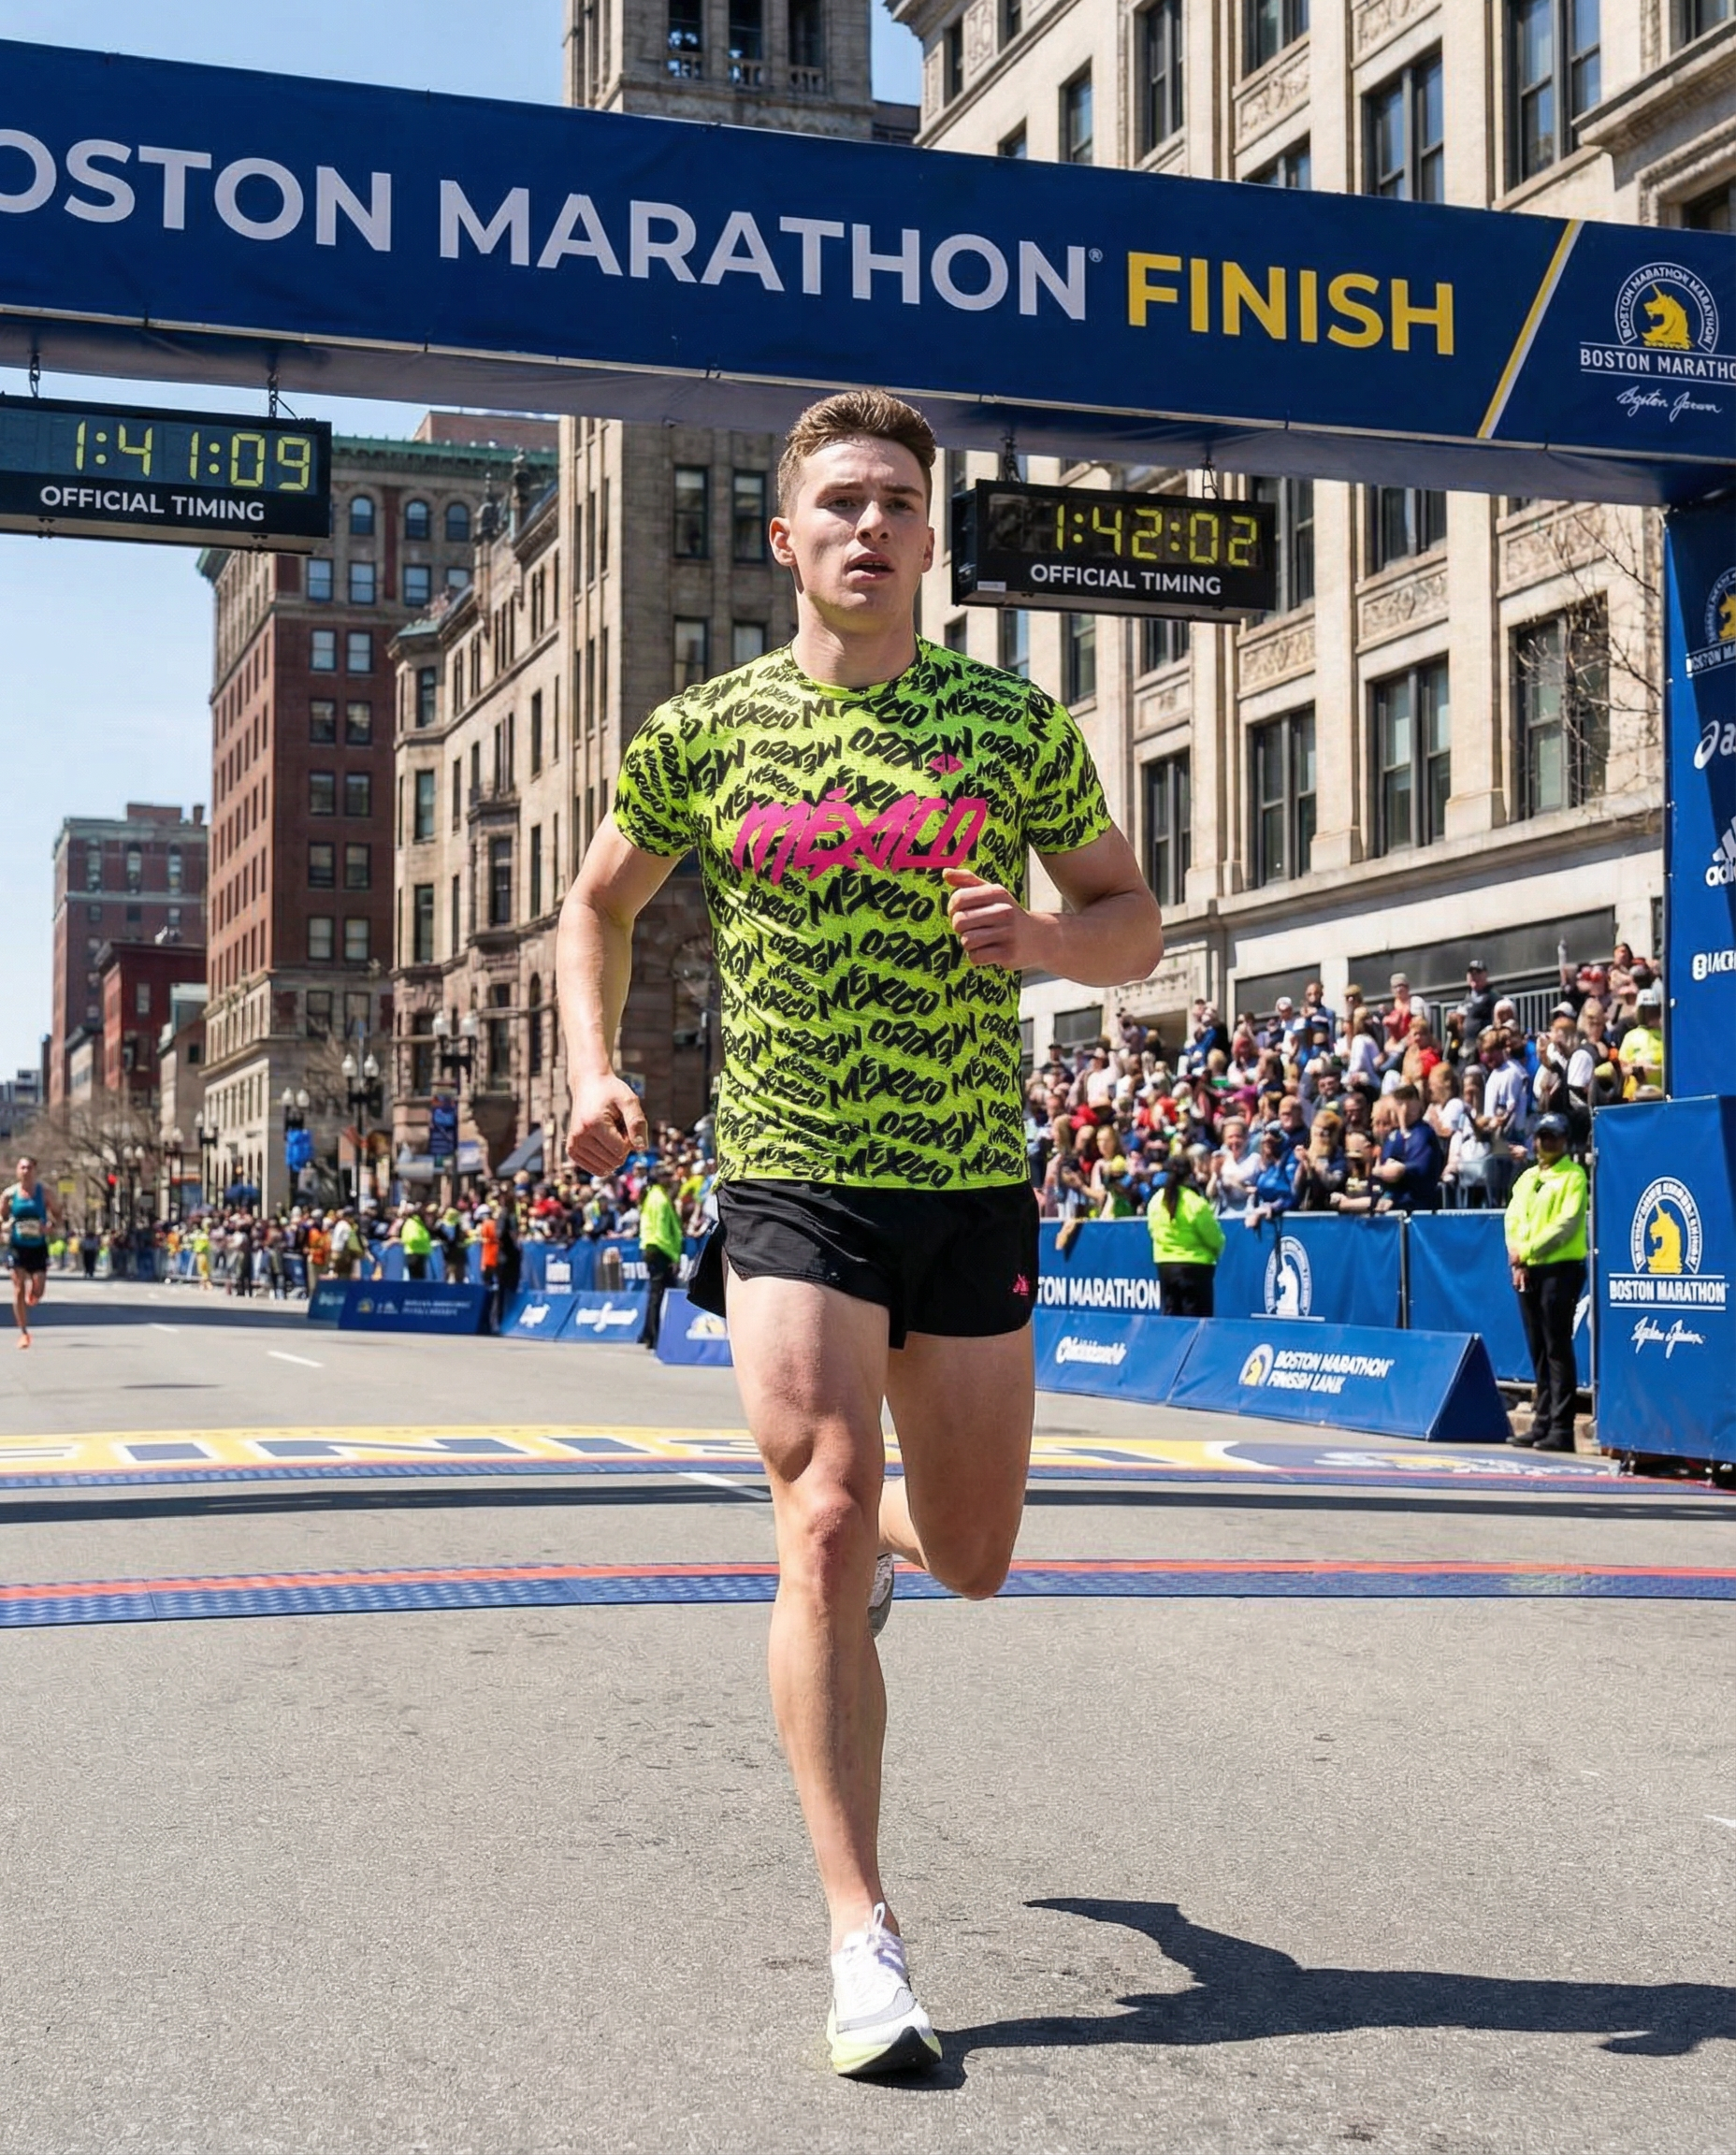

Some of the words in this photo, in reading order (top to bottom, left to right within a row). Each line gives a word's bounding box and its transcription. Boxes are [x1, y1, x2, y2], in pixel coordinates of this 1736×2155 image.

[1127, 250, 1454, 356] FINISH
[1580, 347, 1650, 371] BOSTON
[77, 420, 311, 492] 1:41:09
[39, 485, 165, 515] OFFICIAL
[170, 494, 266, 523] TIMING
[1056, 503, 1258, 567] 1:42:02
[1030, 563, 1136, 590] OFFICIAL
[1140, 571, 1222, 595] TIMING
[1068, 1277, 1162, 1310] MARATHON
[1609, 1280, 1656, 1301] BOSTON
[1656, 1280, 1727, 1304] MARATHON
